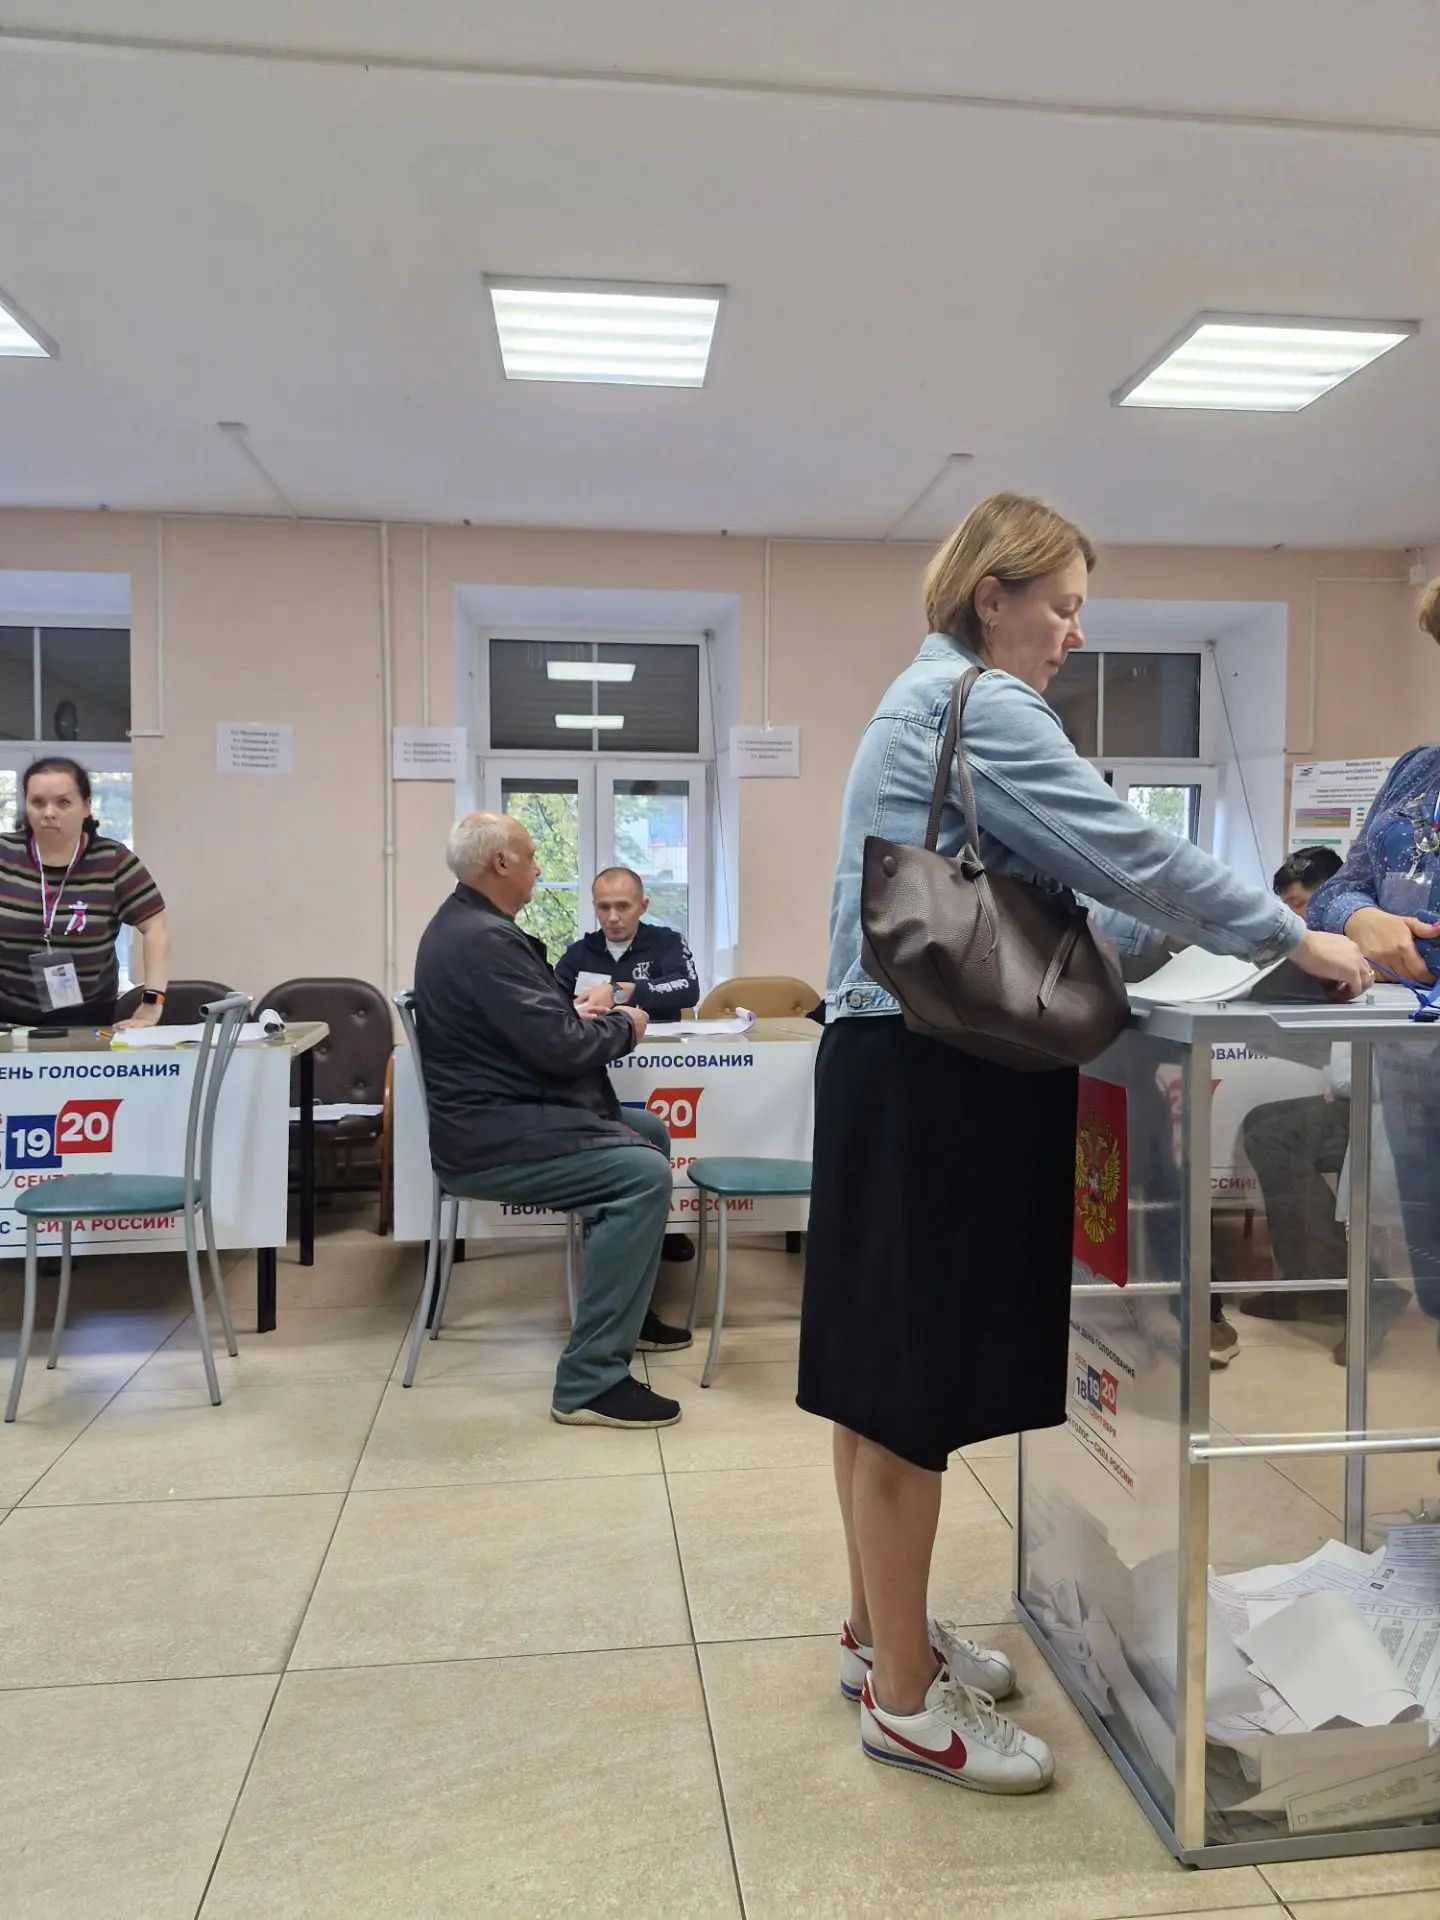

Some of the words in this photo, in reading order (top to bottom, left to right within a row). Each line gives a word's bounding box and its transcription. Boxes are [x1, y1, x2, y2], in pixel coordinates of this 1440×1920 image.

[628, 1054, 754, 1069] ГОЛОСОВАНИЯ
[0, 1066, 33, 1080] ЕНЬ
[39, 1063, 180, 1079] ГОЛОСОВАНИЯ
[650, 1099, 693, 1127] 20
[11, 1127, 52, 1159] 19
[60, 1111, 110, 1142] 20
[1210, 1177, 1258, 1190] ССИИ!
[680, 1198, 754, 1212] РОССИИ!
[35, 1219, 86, 1234] СИА
[91, 1216, 175, 1232] РОССИИ!
[1076, 1376, 1087, 1401] 18
[1088, 1376, 1100, 1401] 19
[1101, 1376, 1116, 1405] 20
